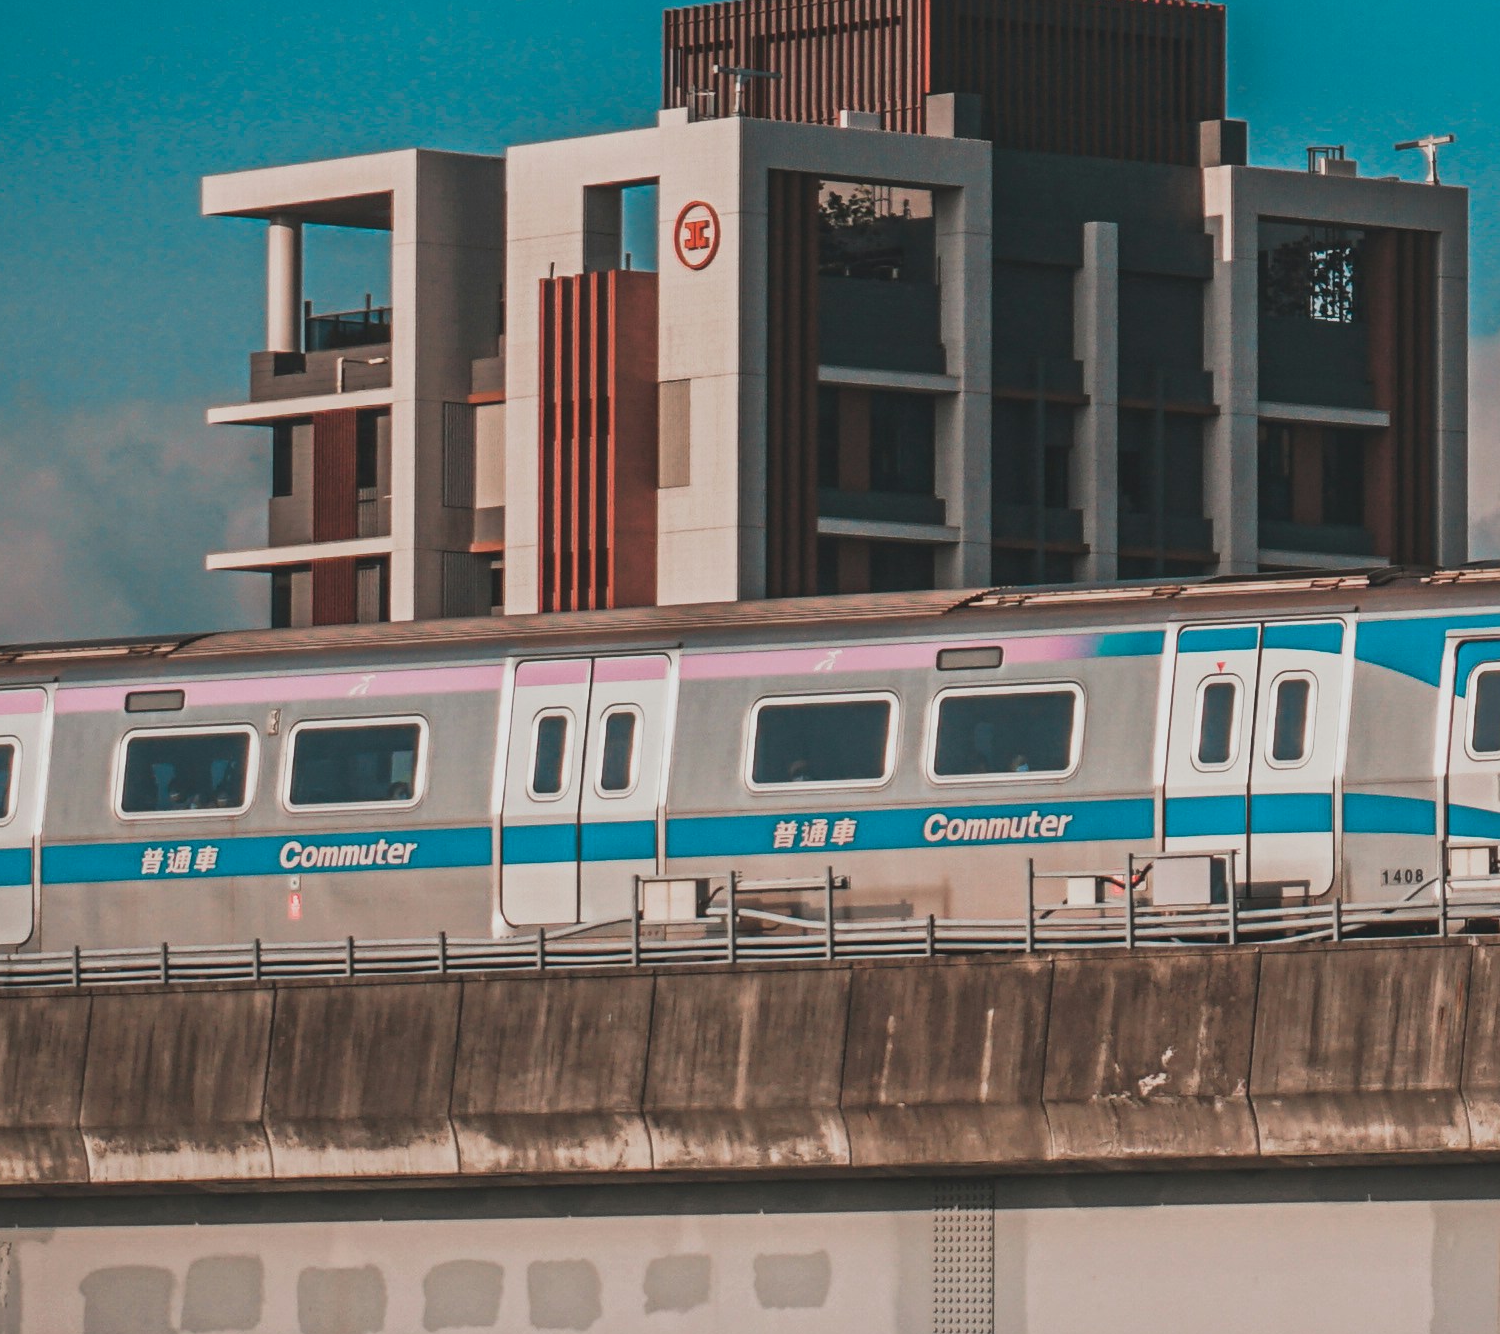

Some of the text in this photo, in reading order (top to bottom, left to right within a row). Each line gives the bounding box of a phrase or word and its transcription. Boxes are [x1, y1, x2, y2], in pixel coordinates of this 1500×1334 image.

[772, 817, 857, 849] 普通車
[923, 811, 1073, 842] Commuter
[141, 845, 219, 875] 普通車
[280, 838, 418, 869] Commuter
[1382, 868, 1424, 885] 1408
